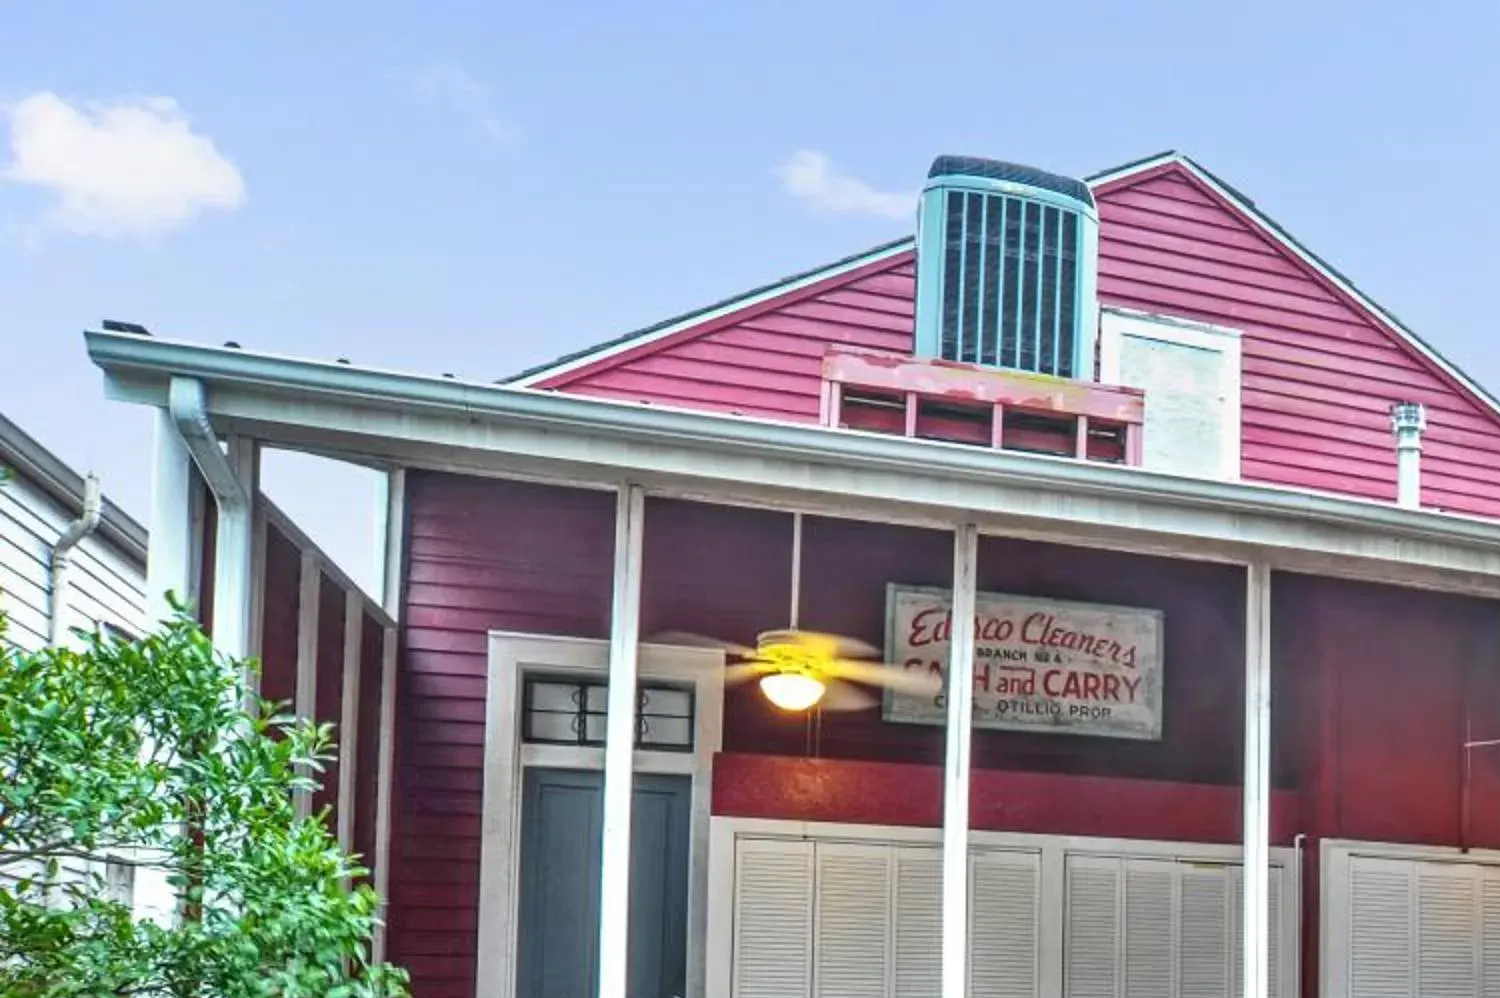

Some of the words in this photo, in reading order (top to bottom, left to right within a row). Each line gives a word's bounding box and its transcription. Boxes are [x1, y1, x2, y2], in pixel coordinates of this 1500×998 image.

[976, 646, 1028, 661] BRANCH
[1021, 611, 1137, 668] Cleaners
[996, 665, 1035, 696] and
[1043, 669, 1142, 703] CARRY
